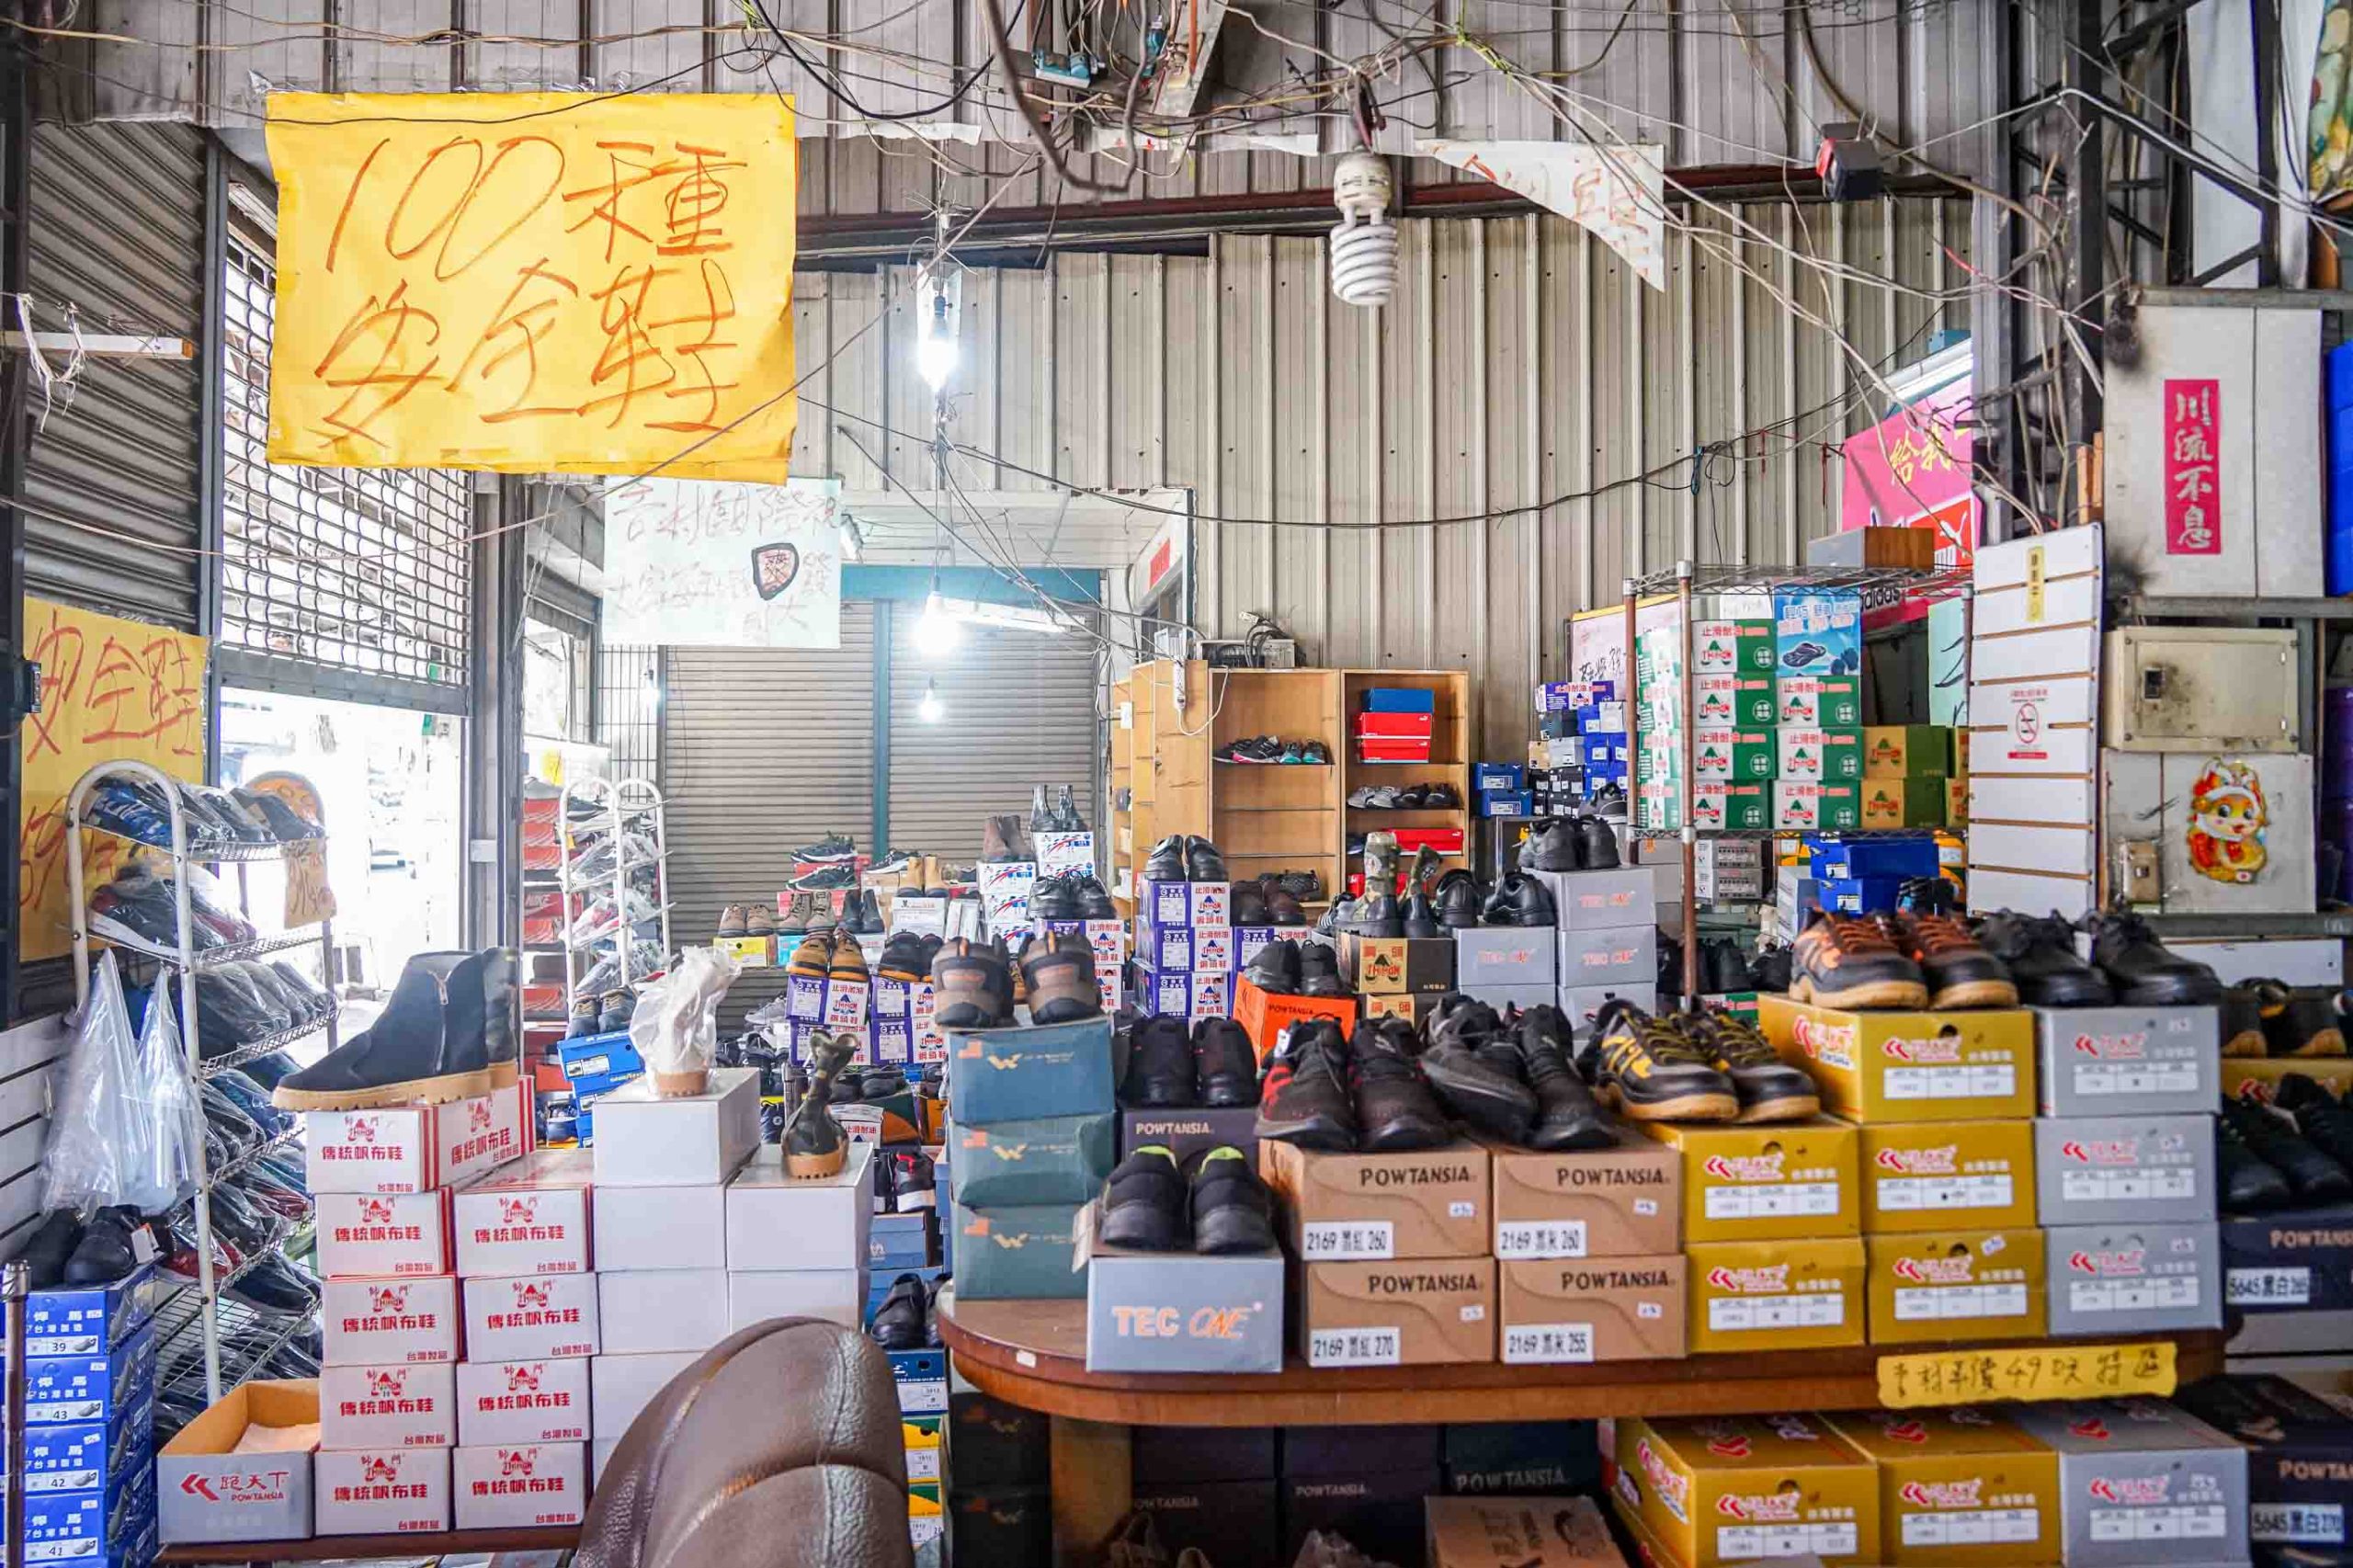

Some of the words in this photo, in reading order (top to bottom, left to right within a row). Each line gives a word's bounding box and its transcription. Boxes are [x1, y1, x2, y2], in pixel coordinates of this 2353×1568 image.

[2175, 386, 2213, 550] 川流不息
[1136, 1122, 1210, 1135] POWTANSIA
[322, 1146, 404, 1161] 傳統帆布鞋
[451, 1127, 510, 1165] 傳統帆布鞋
[1360, 1166, 1470, 1187] POWTANSIA
[1557, 1167, 1664, 1187] POWTANSIA
[335, 1226, 422, 1242] 傳統帆布鞋
[475, 1225, 564, 1244] 傳統帆布鞋
[1306, 1232, 1336, 1251] 2169
[1368, 1230, 1387, 1250] 260
[1501, 1232, 1530, 1251] 2169
[1369, 1275, 1478, 1294] POWTANSIA
[1563, 1271, 1669, 1290] POWTANSIA
[343, 1314, 437, 1333] 傳統帆布鞋
[487, 1309, 581, 1329] 傳統帆布鞋
[1112, 1305, 1180, 1337] TEC
[1188, 1306, 1251, 1340] ONE
[51, 1342, 67, 1352] 39
[1313, 1338, 1344, 1358] 2169
[1375, 1336, 1394, 1357] 270
[1508, 1335, 1538, 1354] 2169
[340, 1398, 434, 1416] 傳統帆布鞋
[479, 1392, 571, 1411] 傳統帆布鞋
[52, 1410, 68, 1420] 43
[51, 1478, 65, 1488] 42
[221, 1471, 290, 1492] 跑天下
[472, 1478, 564, 1495] 傳統帆布鞋
[1456, 1469, 1565, 1491] POWTANSIA
[335, 1484, 427, 1501] 傳統帆布鞋
[1295, 1483, 1367, 1497] POWTANSIA
[49, 1547, 63, 1557] 41
